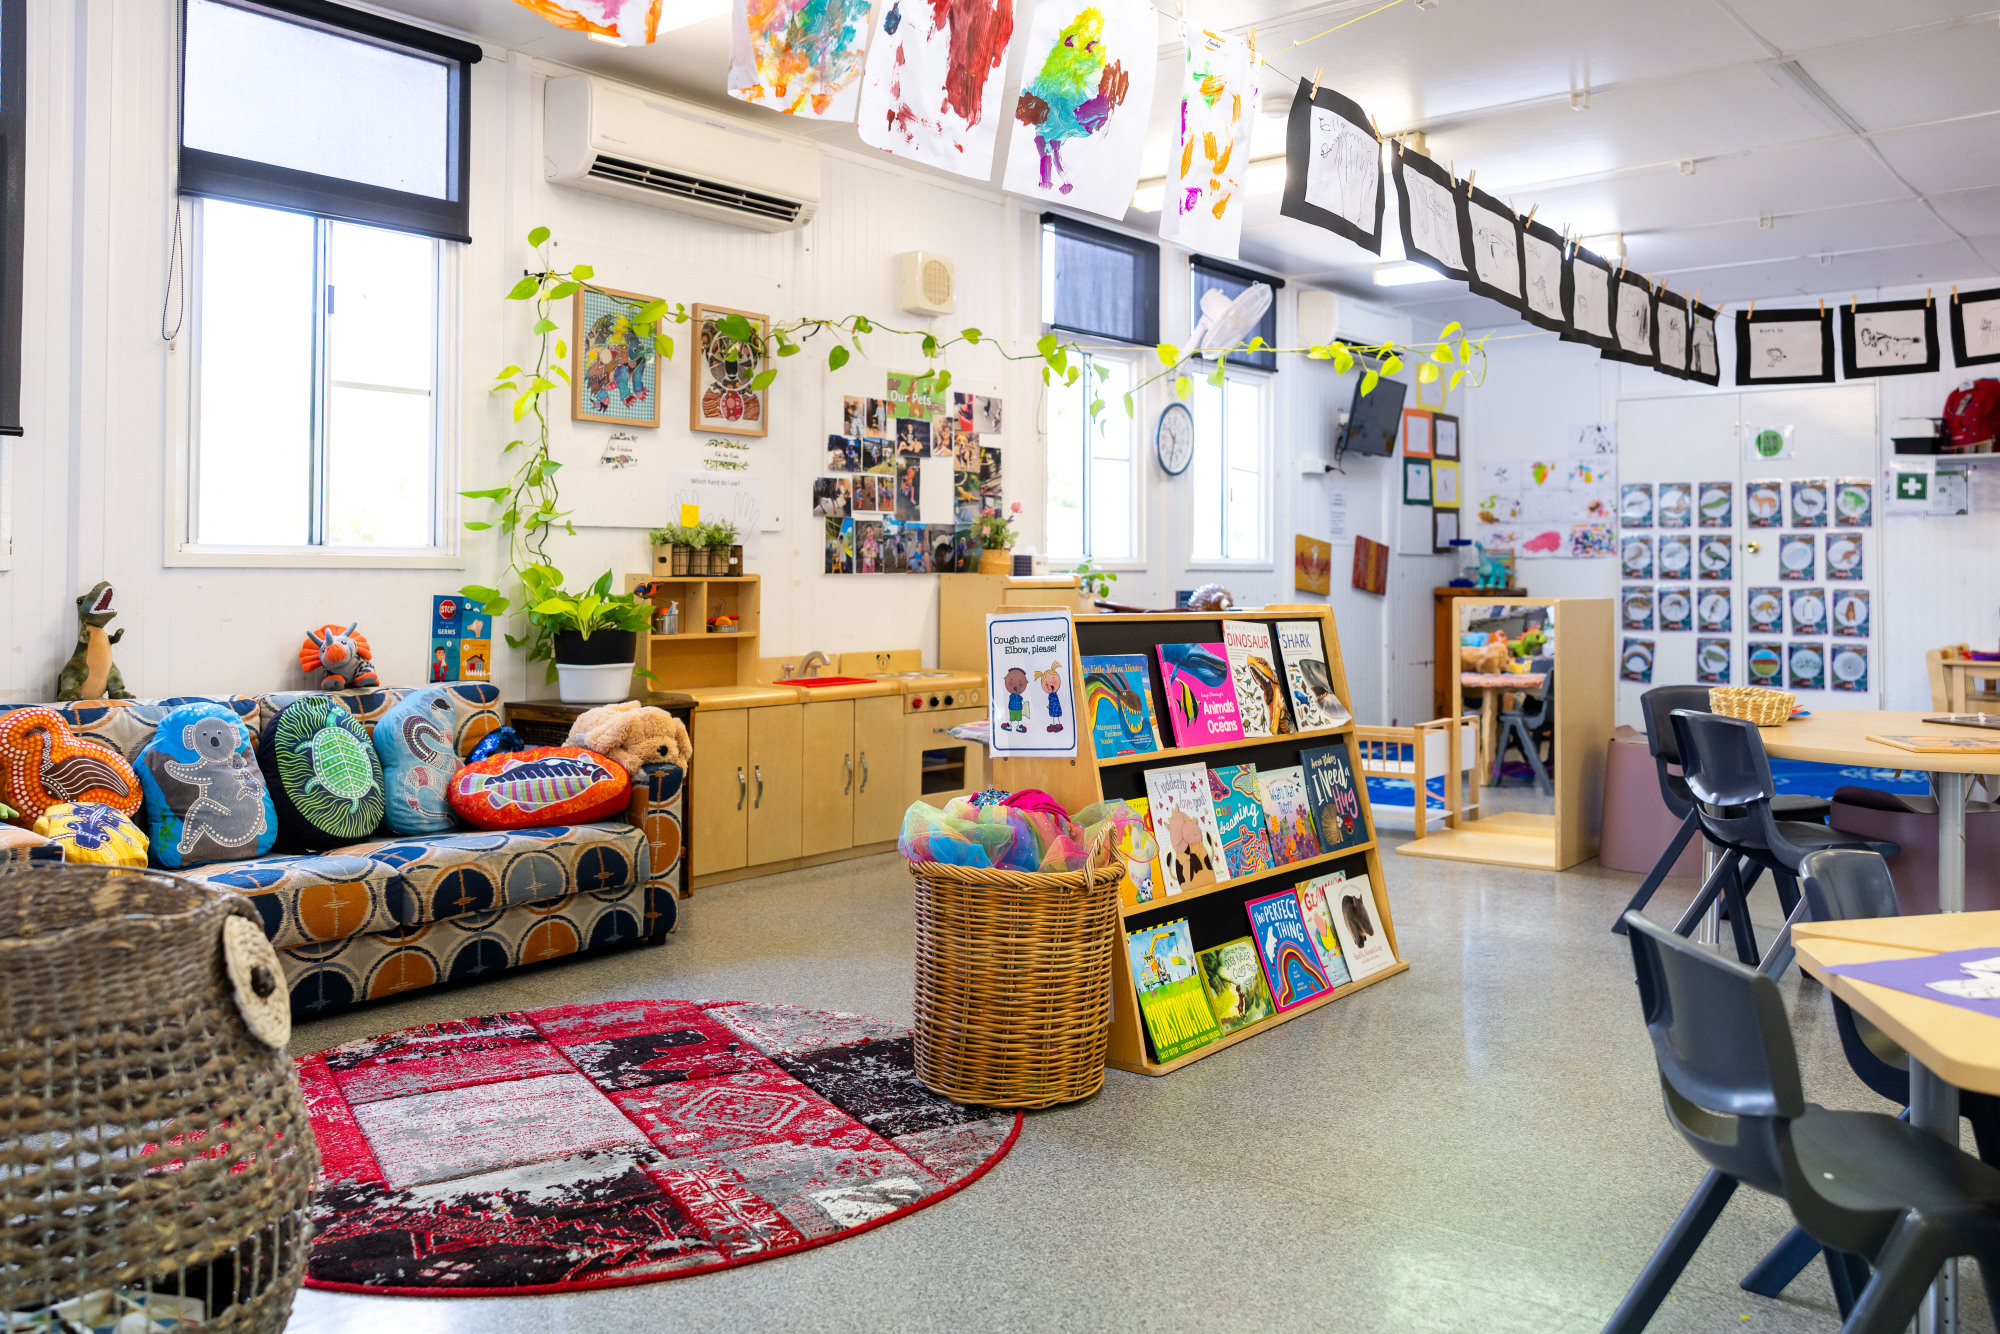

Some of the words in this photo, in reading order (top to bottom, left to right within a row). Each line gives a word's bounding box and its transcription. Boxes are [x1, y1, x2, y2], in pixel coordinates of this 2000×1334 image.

[891, 390, 909, 403] Our
[912, 392, 932, 406] Pets
[440, 606, 455, 614] STOP
[993, 635, 1020, 645] Cough
[1021, 635, 1035, 643] and
[1037, 633, 1066, 642] sneeze?
[1227, 633, 1270, 649] DINOSAUR
[1282, 634, 1311, 648] SHARK
[1005, 646, 1030, 655] Elbow,
[1032, 644, 1057, 655] please!
[1091, 665, 1105, 673] Little
[1106, 664, 1123, 672] Yellow
[1204, 699, 1235, 715] Animals
[1208, 720, 1238, 733] Oceans
[1155, 782, 1162, 798] I
[1161, 772, 1187, 794] udderly
[1312, 774, 1324, 806] I
[1318, 759, 1347, 803] Need
[1344, 767, 1350, 777] a
[1179, 791, 1193, 809] love
[1193, 788, 1206, 811] you!
[1332, 785, 1358, 819] Hug
[1216, 804, 1232, 817] abc
[1254, 911, 1265, 926] the
[1264, 899, 1298, 923] PERFECT
[1146, 988, 1216, 1049] CONSTRUCTION
